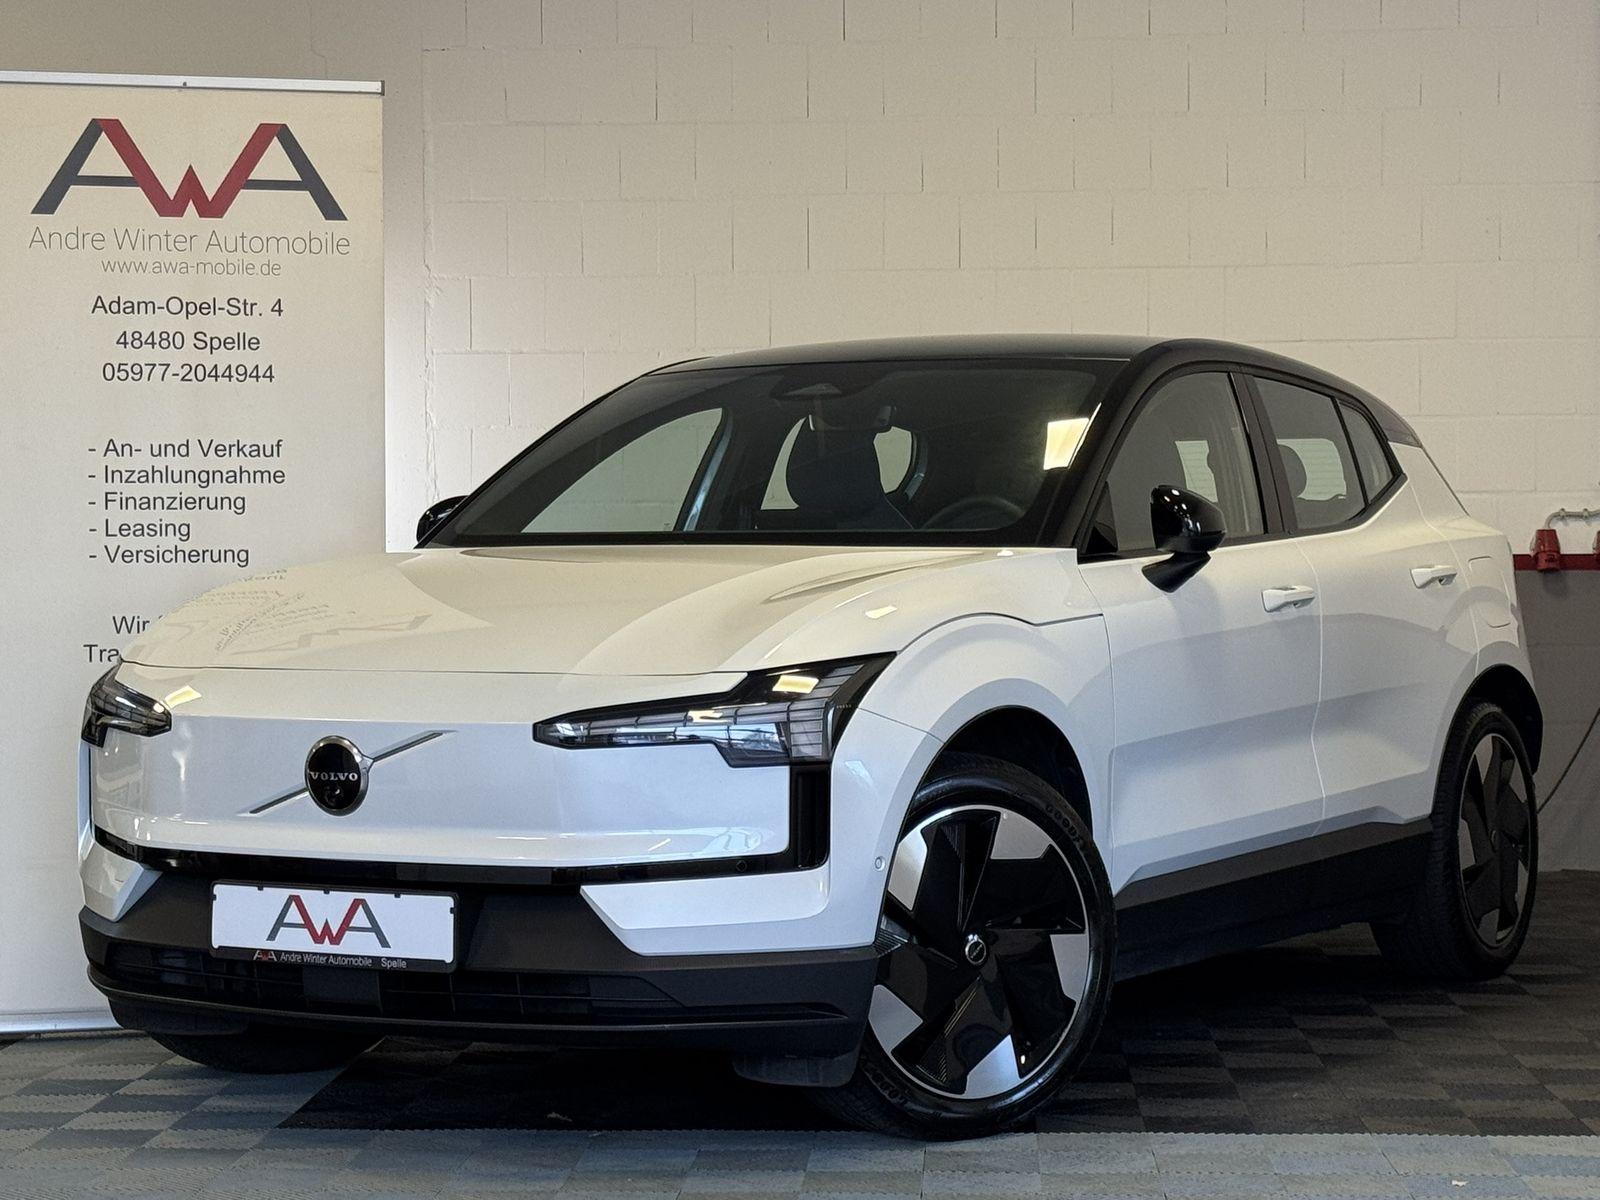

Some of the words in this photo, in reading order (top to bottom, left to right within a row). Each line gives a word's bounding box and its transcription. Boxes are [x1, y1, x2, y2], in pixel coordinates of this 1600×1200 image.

[29, 226, 105, 251] Andre
[113, 228, 198, 252] Winter
[205, 230, 350, 255] Automobile
[102, 259, 281, 276] www.awa-mobile.de
[91, 295, 263, 319] Adam-Opel-Str.
[271, 298, 283, 316] 4
[116, 331, 185, 350] 48480
[193, 331, 260, 354] Spelle
[102, 362, 275, 382] 05977-2044944
[104, 439, 142, 457] An-
[150, 439, 189, 458] und
[198, 439, 283, 458] Verkauf
[104, 465, 286, 488] Inzahlungnahme
[104, 492, 246, 515] Finanzierung
[105, 518, 191, 541] Leasing
[104, 545, 249, 568] Versicherung
[113, 616, 150, 634] Wir
[83, 644, 119, 662] Tra
[309, 772, 358, 781] VOLVO
[280, 951, 302, 962] Andre
[303, 953, 327, 963] Winter
[328, 955, 372, 966] Automobile
[381, 958, 406, 969] Spelle
